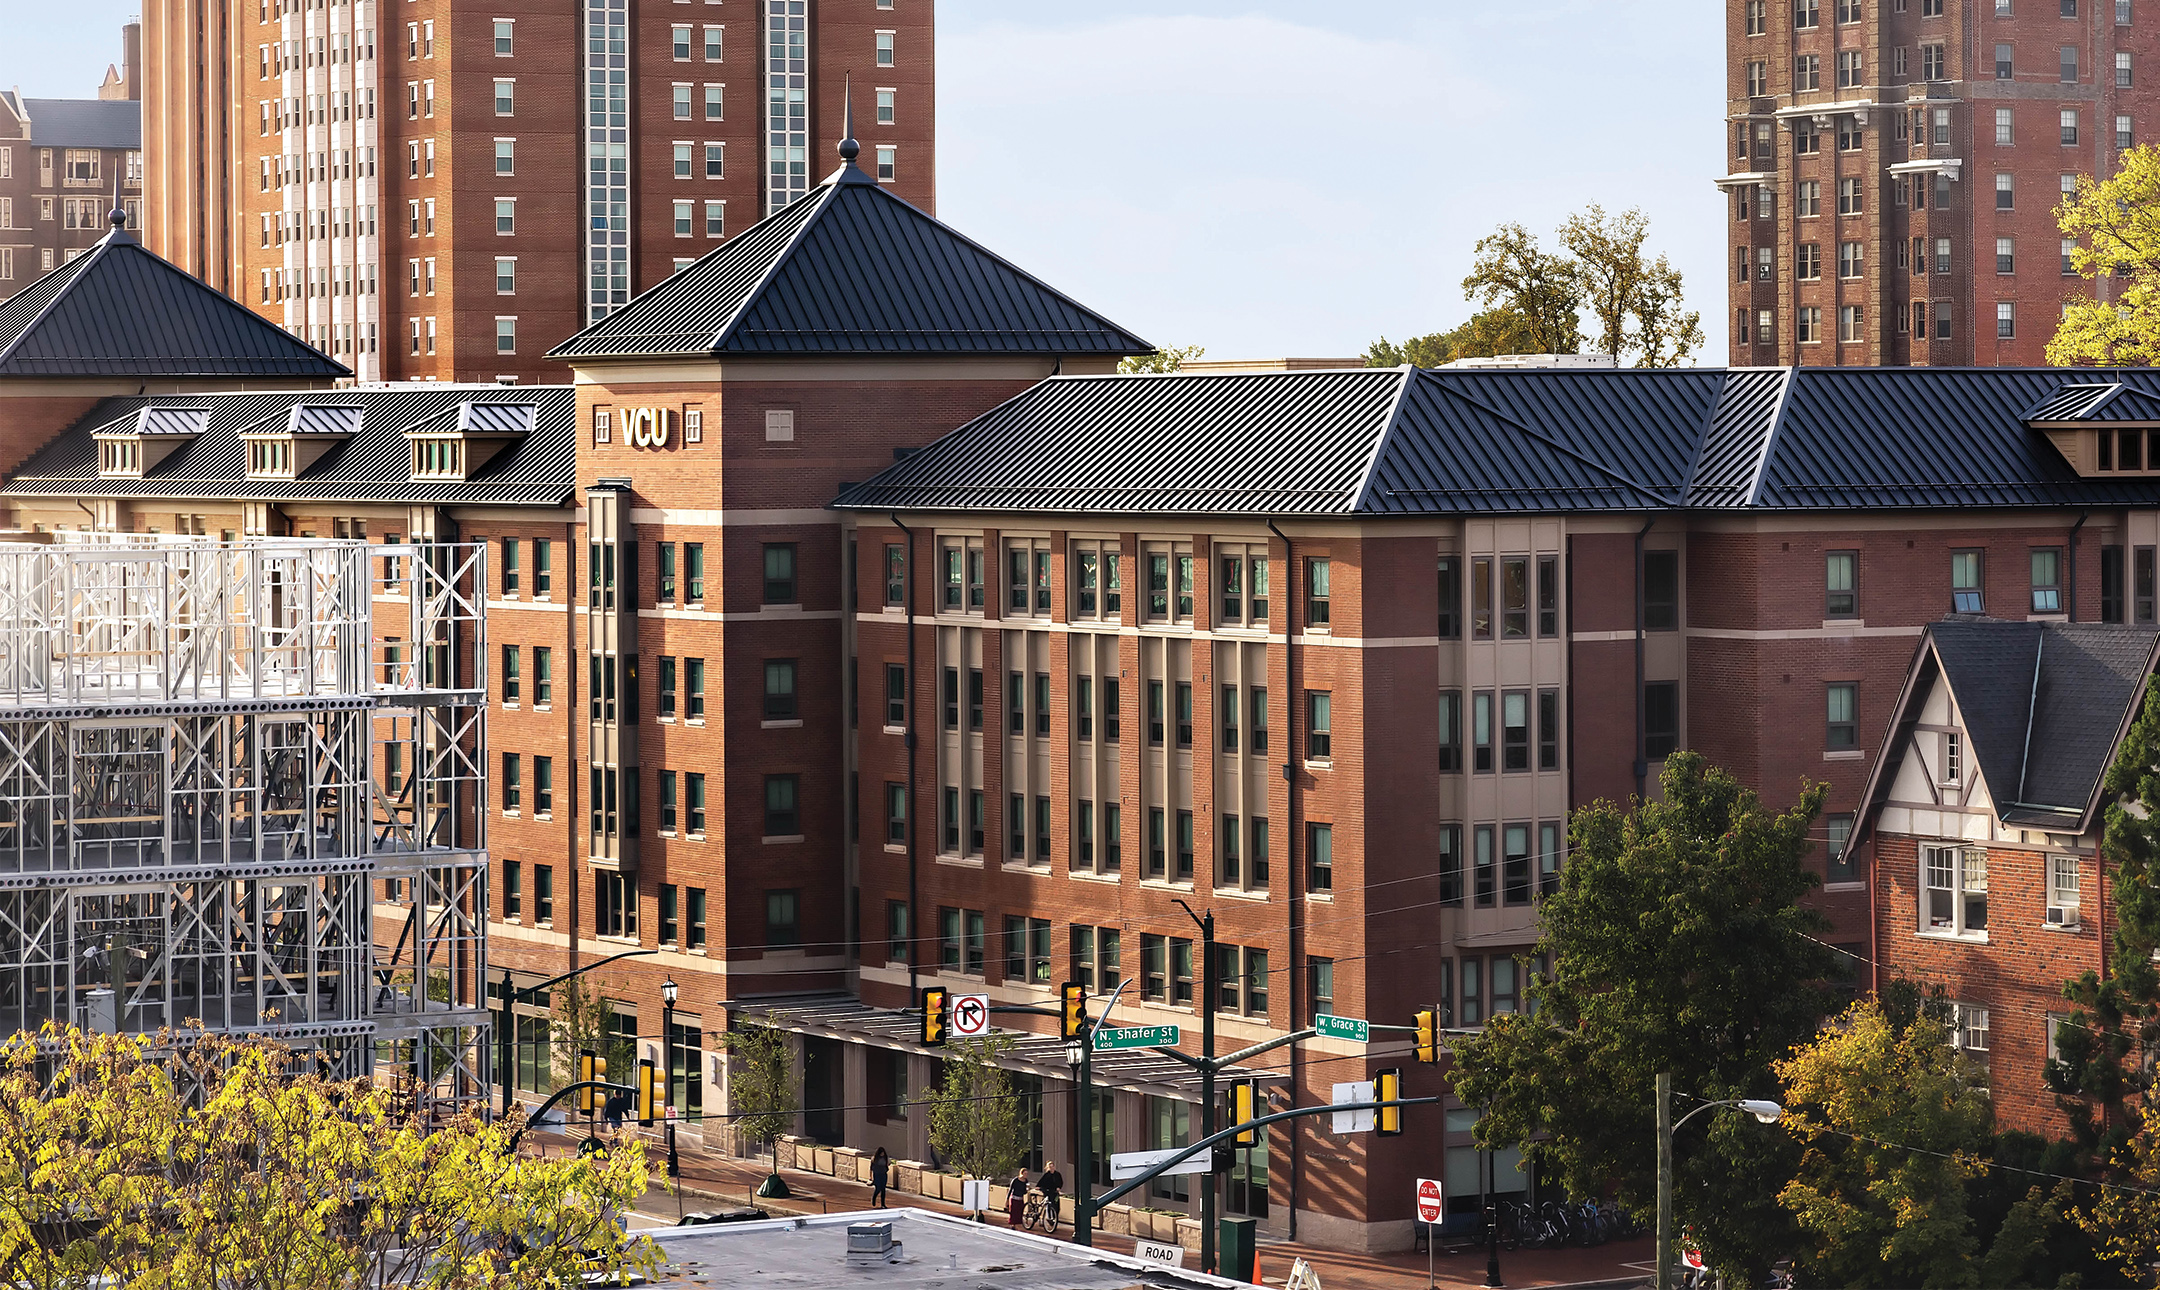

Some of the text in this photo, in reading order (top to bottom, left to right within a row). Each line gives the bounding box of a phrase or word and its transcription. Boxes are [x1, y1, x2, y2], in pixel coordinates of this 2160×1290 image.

[620, 407, 669, 447] VCU
[1318, 1017, 1366, 1033] W. Grace St
[1100, 1026, 1173, 1041] N. Shafer St
[1421, 1186, 1438, 1195] DO NOT
[1422, 1208, 1437, 1217] ENTER
[1145, 1246, 1174, 1261] ROAD
